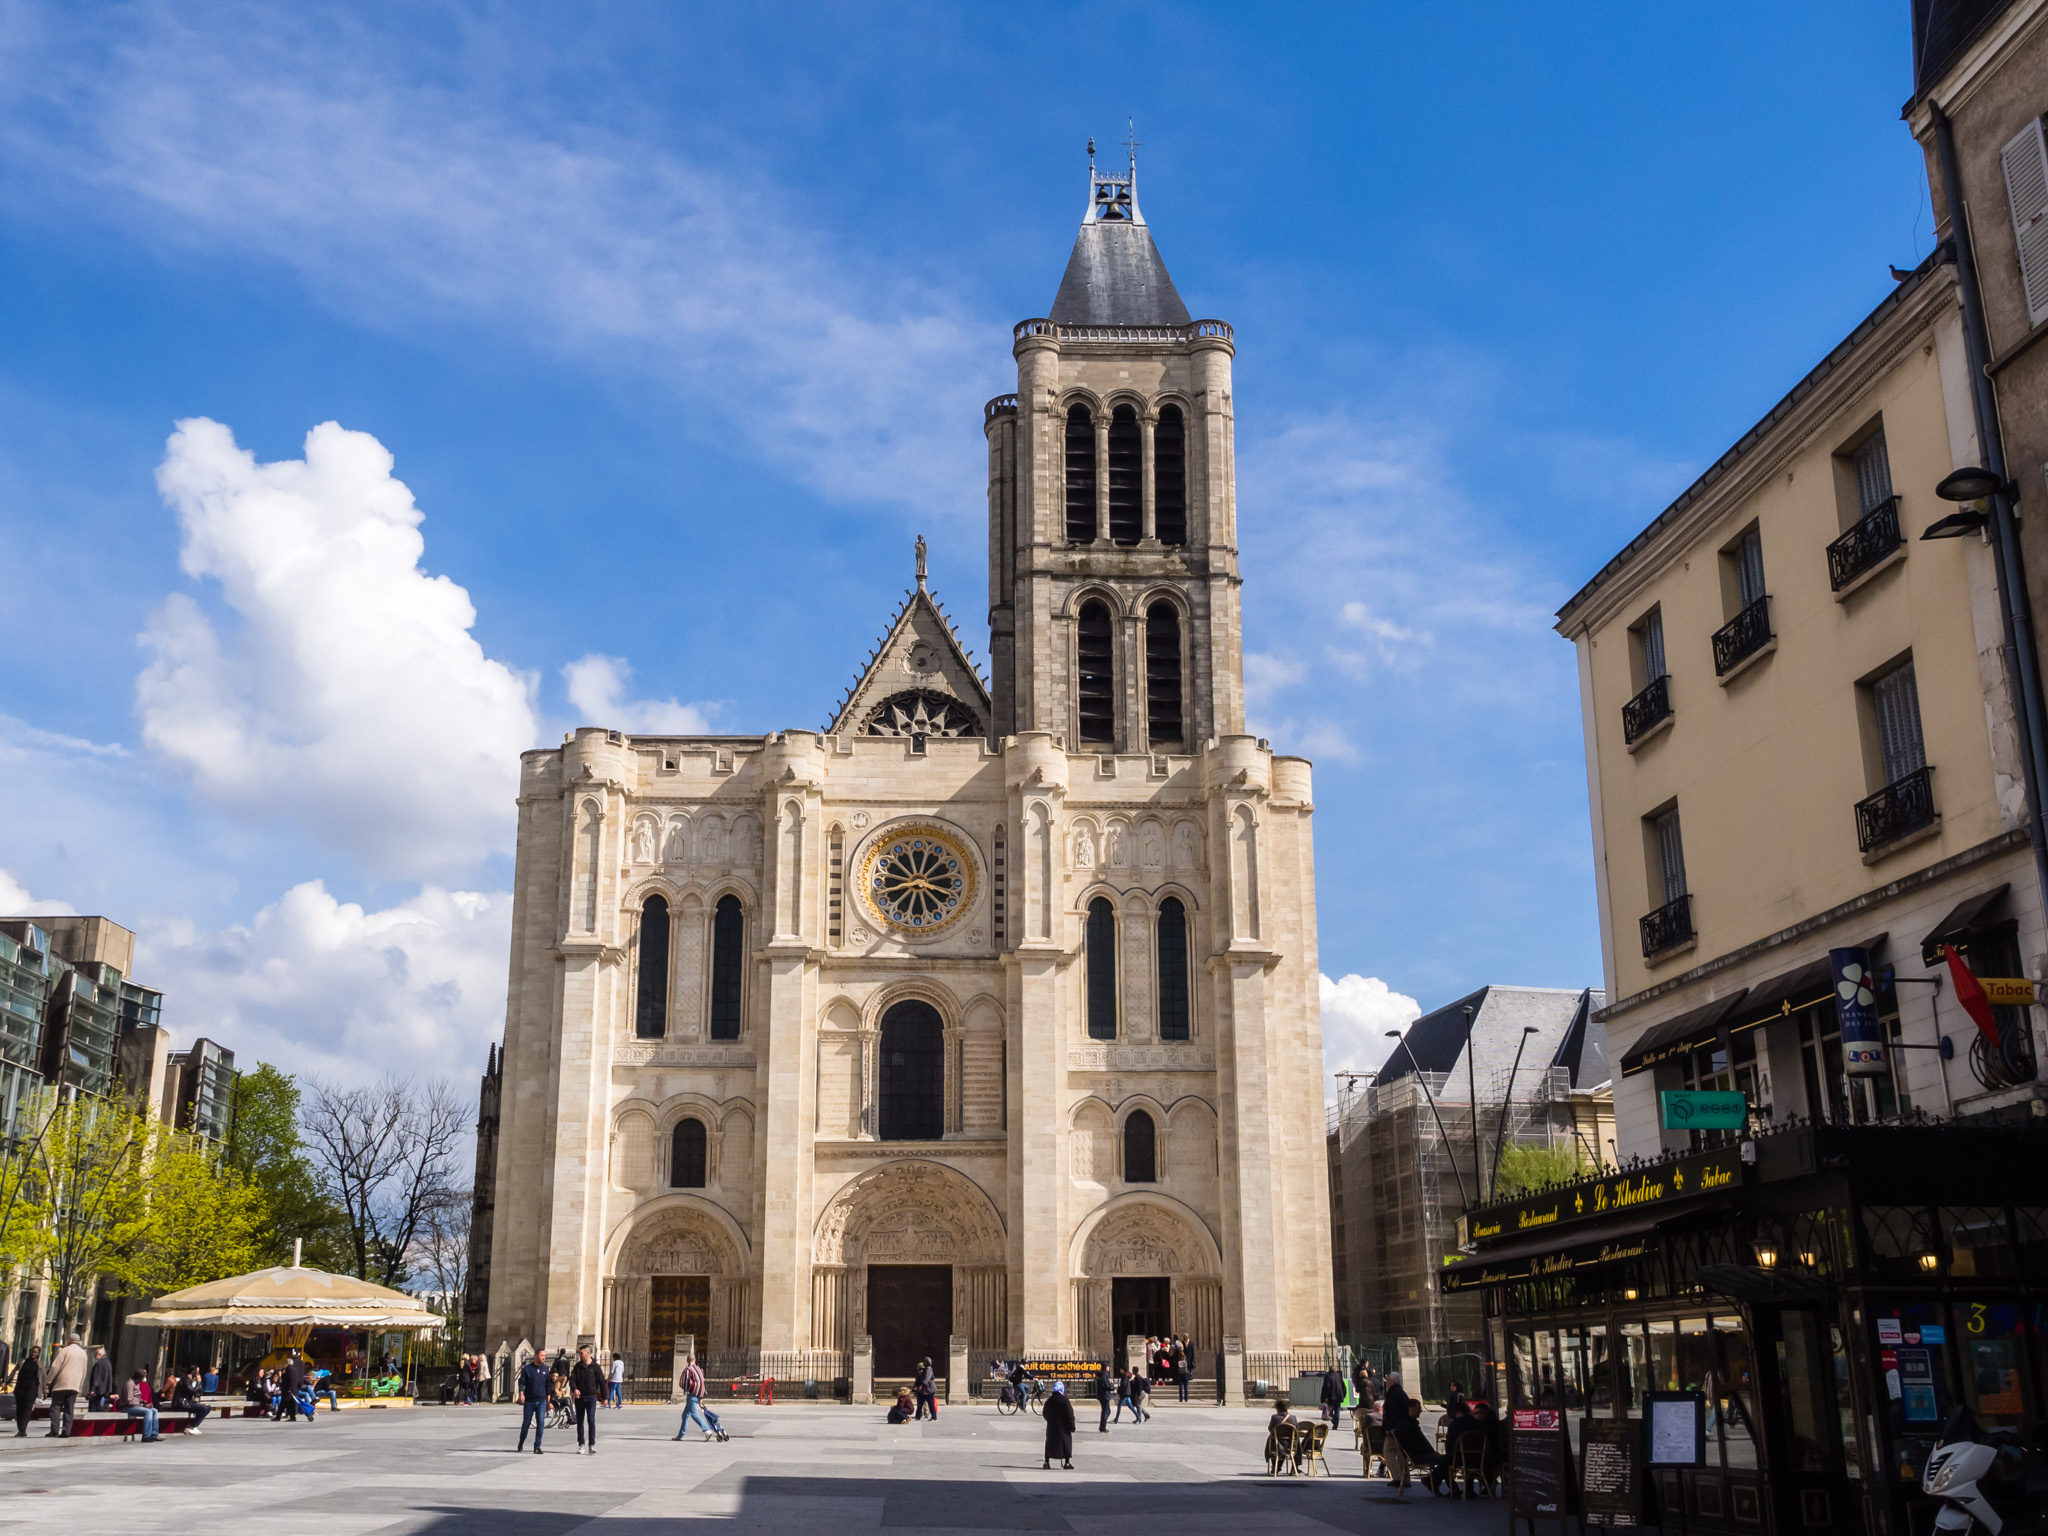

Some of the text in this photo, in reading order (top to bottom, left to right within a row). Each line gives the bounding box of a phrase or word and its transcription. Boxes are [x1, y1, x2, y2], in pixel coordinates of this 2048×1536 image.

[1933, 943, 1958, 957] Tac
[1986, 983, 2032, 996] Tabac
[1473, 1165, 1731, 1239] Brasserie Restaurant Le Khedive Tabac
[1480, 1268, 1507, 1284] Brasserie
[1530, 1257, 1540, 1276] Le
[1542, 1253, 1573, 1274] Khedive
[1599, 1238, 1644, 1262] Restaurant
[1967, 1302, 1987, 1333] 3
[1027, 1361, 1102, 1371] uit des cathédrale
